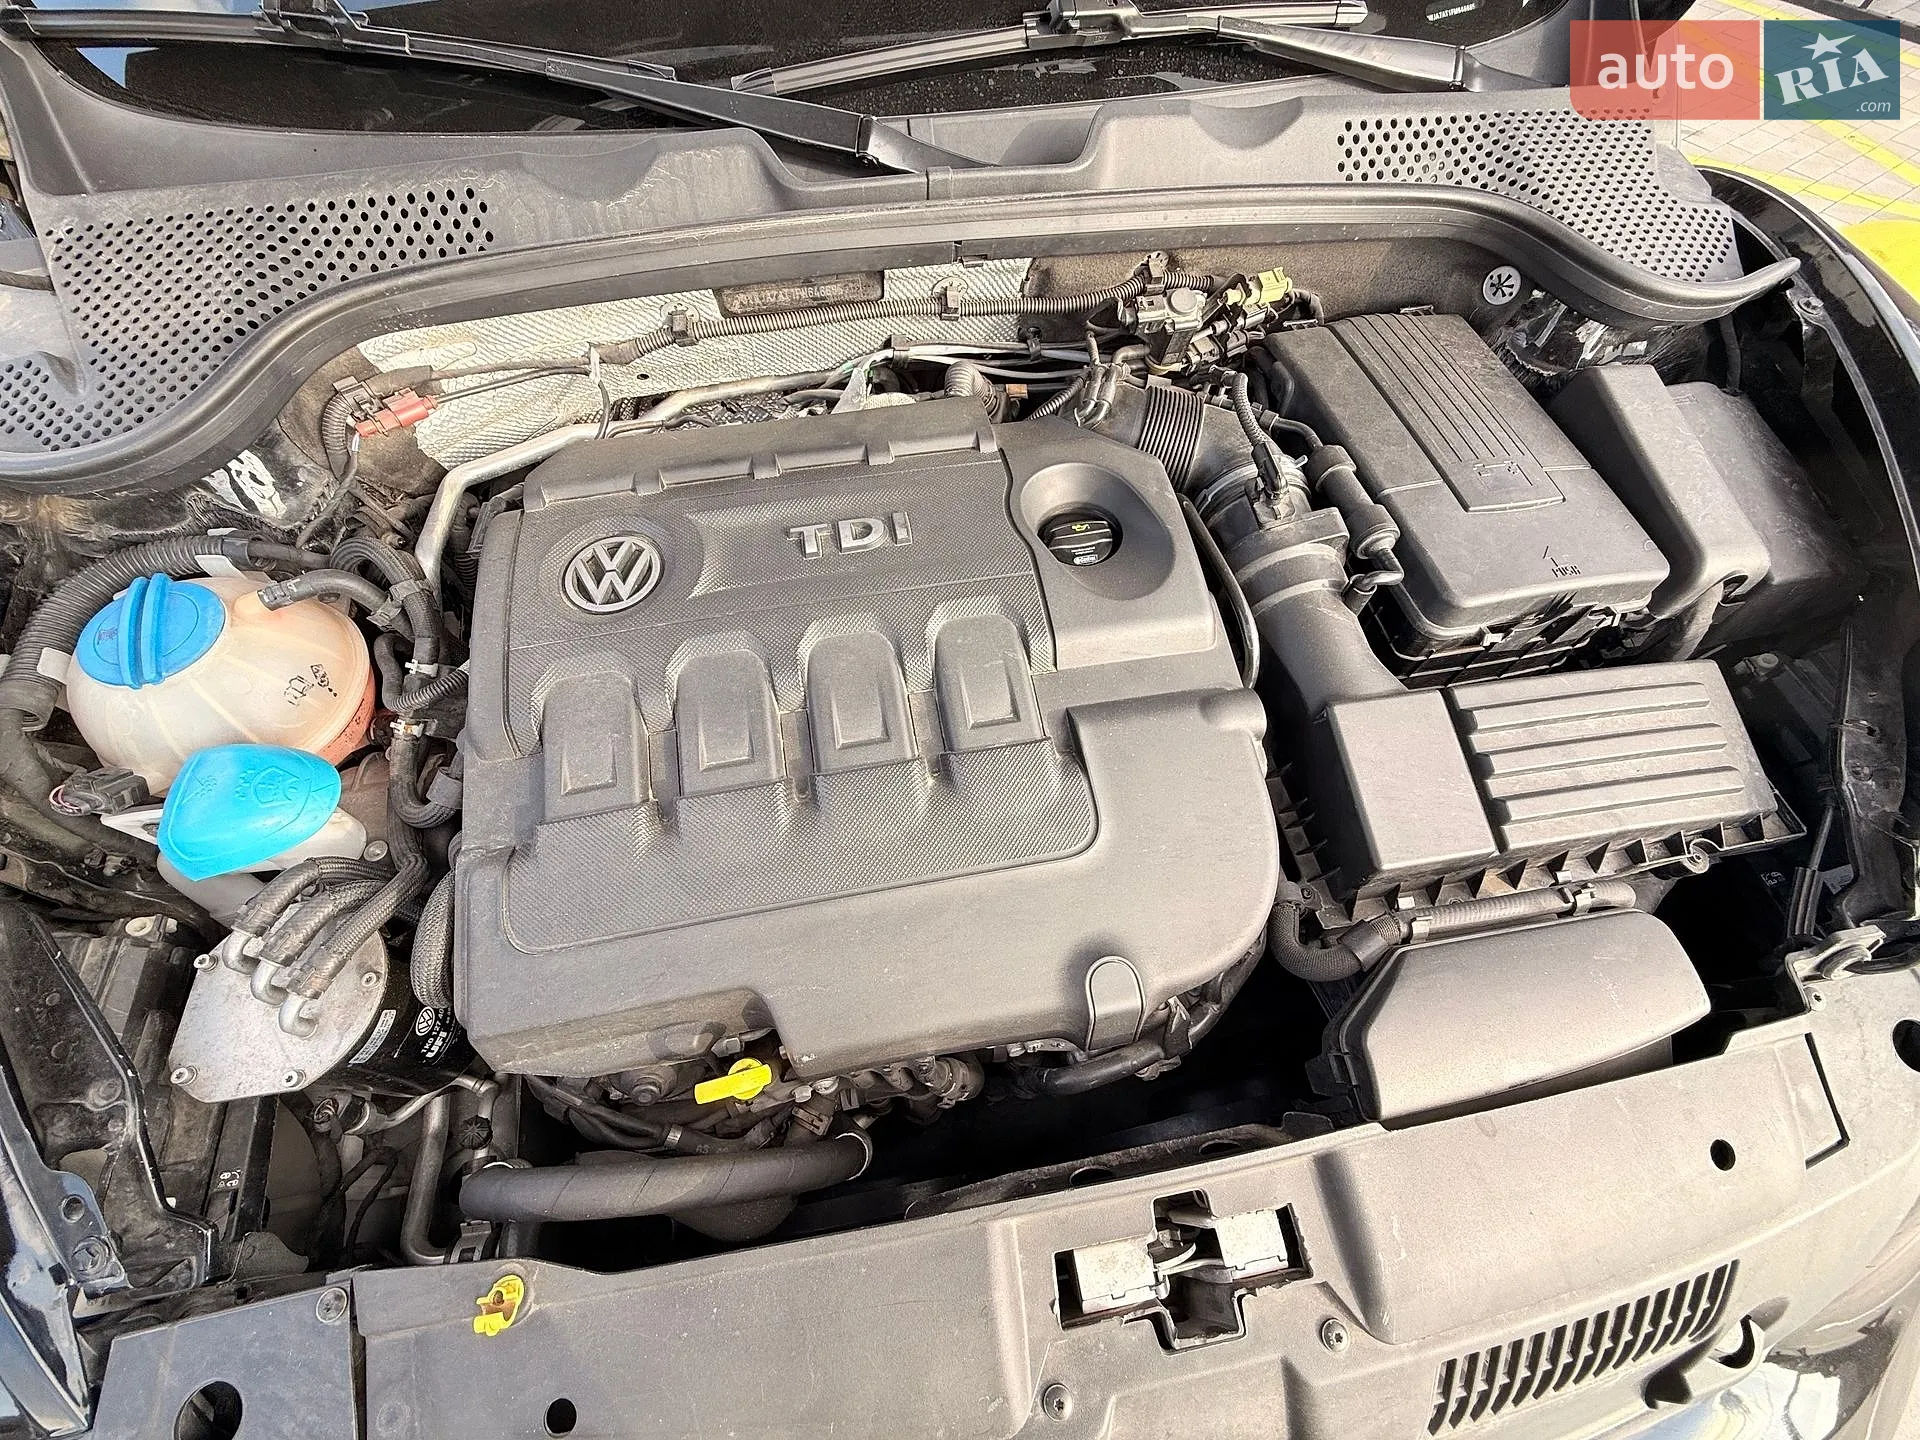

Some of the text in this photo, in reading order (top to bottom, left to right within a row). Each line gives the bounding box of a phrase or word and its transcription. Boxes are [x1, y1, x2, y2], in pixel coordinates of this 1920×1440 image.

[788, 512, 913, 560] TDI
[562, 533, 665, 615] VW
[1551, 565, 1581, 578] PUSH
[425, 1031, 448, 1058] UFI
